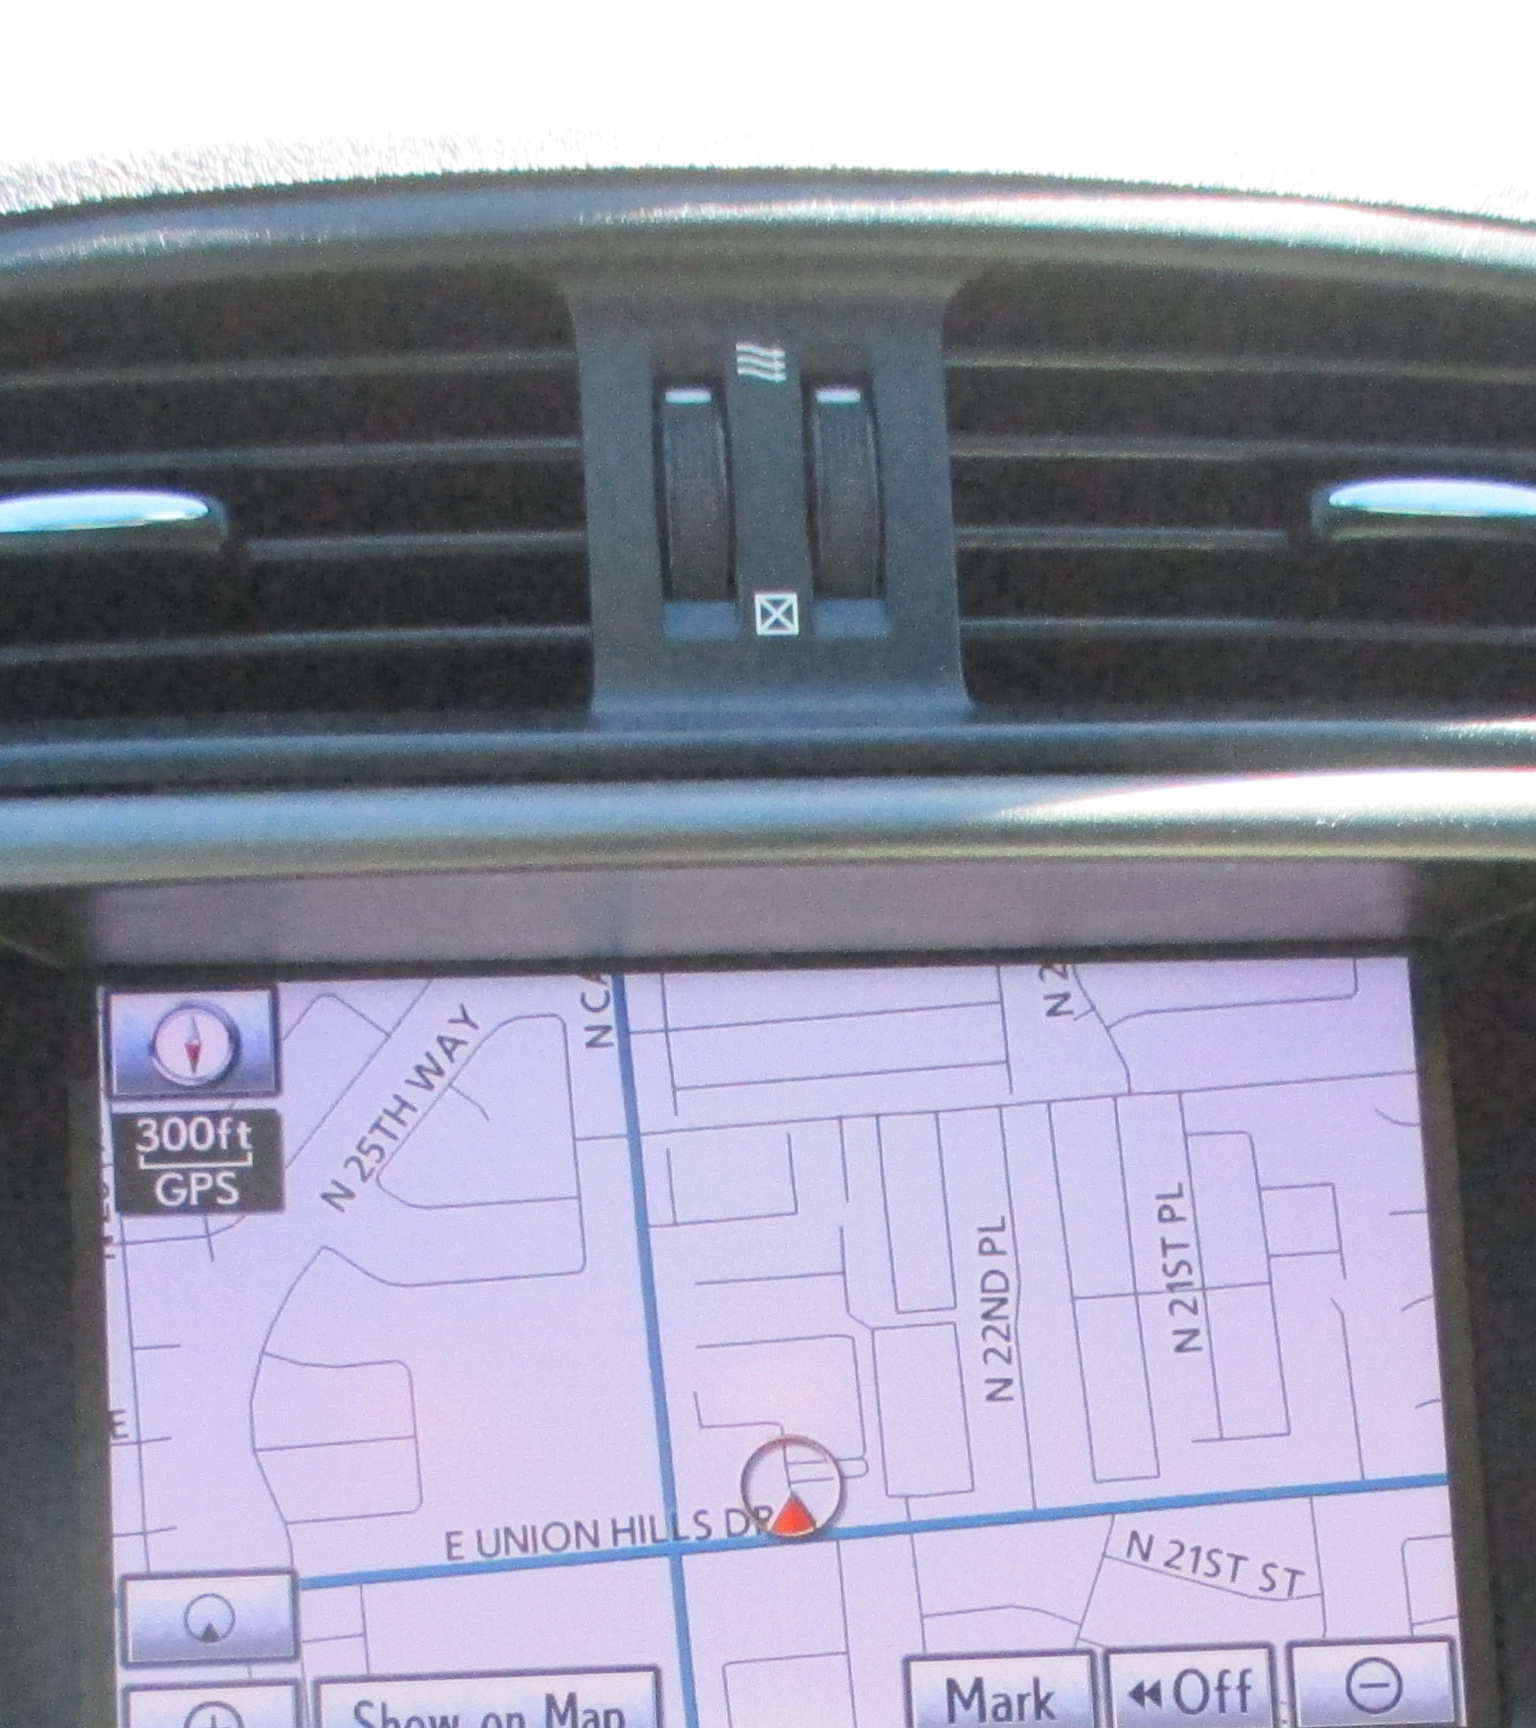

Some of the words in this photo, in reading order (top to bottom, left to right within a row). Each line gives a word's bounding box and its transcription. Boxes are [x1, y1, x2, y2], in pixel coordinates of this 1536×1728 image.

[580, 974, 611, 1014] C
[1044, 991, 1074, 1017] N
[584, 1024, 615, 1050] N
[320, 1180, 356, 1214] N
[346, 1093, 420, 1185] 25TH
[404, 1002, 482, 1095] WAY
[135, 1115, 254, 1152] 300ft
[154, 1170, 240, 1207] GPS
[1155, 1181, 1186, 1223] PL
[977, 1215, 1007, 1255] PL
[1161, 1237, 1201, 1321] 21ST
[980, 1268, 1014, 1367] 22ND
[1174, 1327, 1203, 1354] N
[985, 1376, 1014, 1403] N
[446, 1530, 464, 1562] E
[476, 1517, 600, 1560] UNION
[611, 1508, 713, 1548] HILLS
[1126, 1529, 1154, 1562] N
[1163, 1540, 1249, 1584] 21ST
[1258, 1562, 1306, 1598] ST
[946, 1676, 1056, 1725] Mark
[1173, 1667, 1253, 1716] Off
